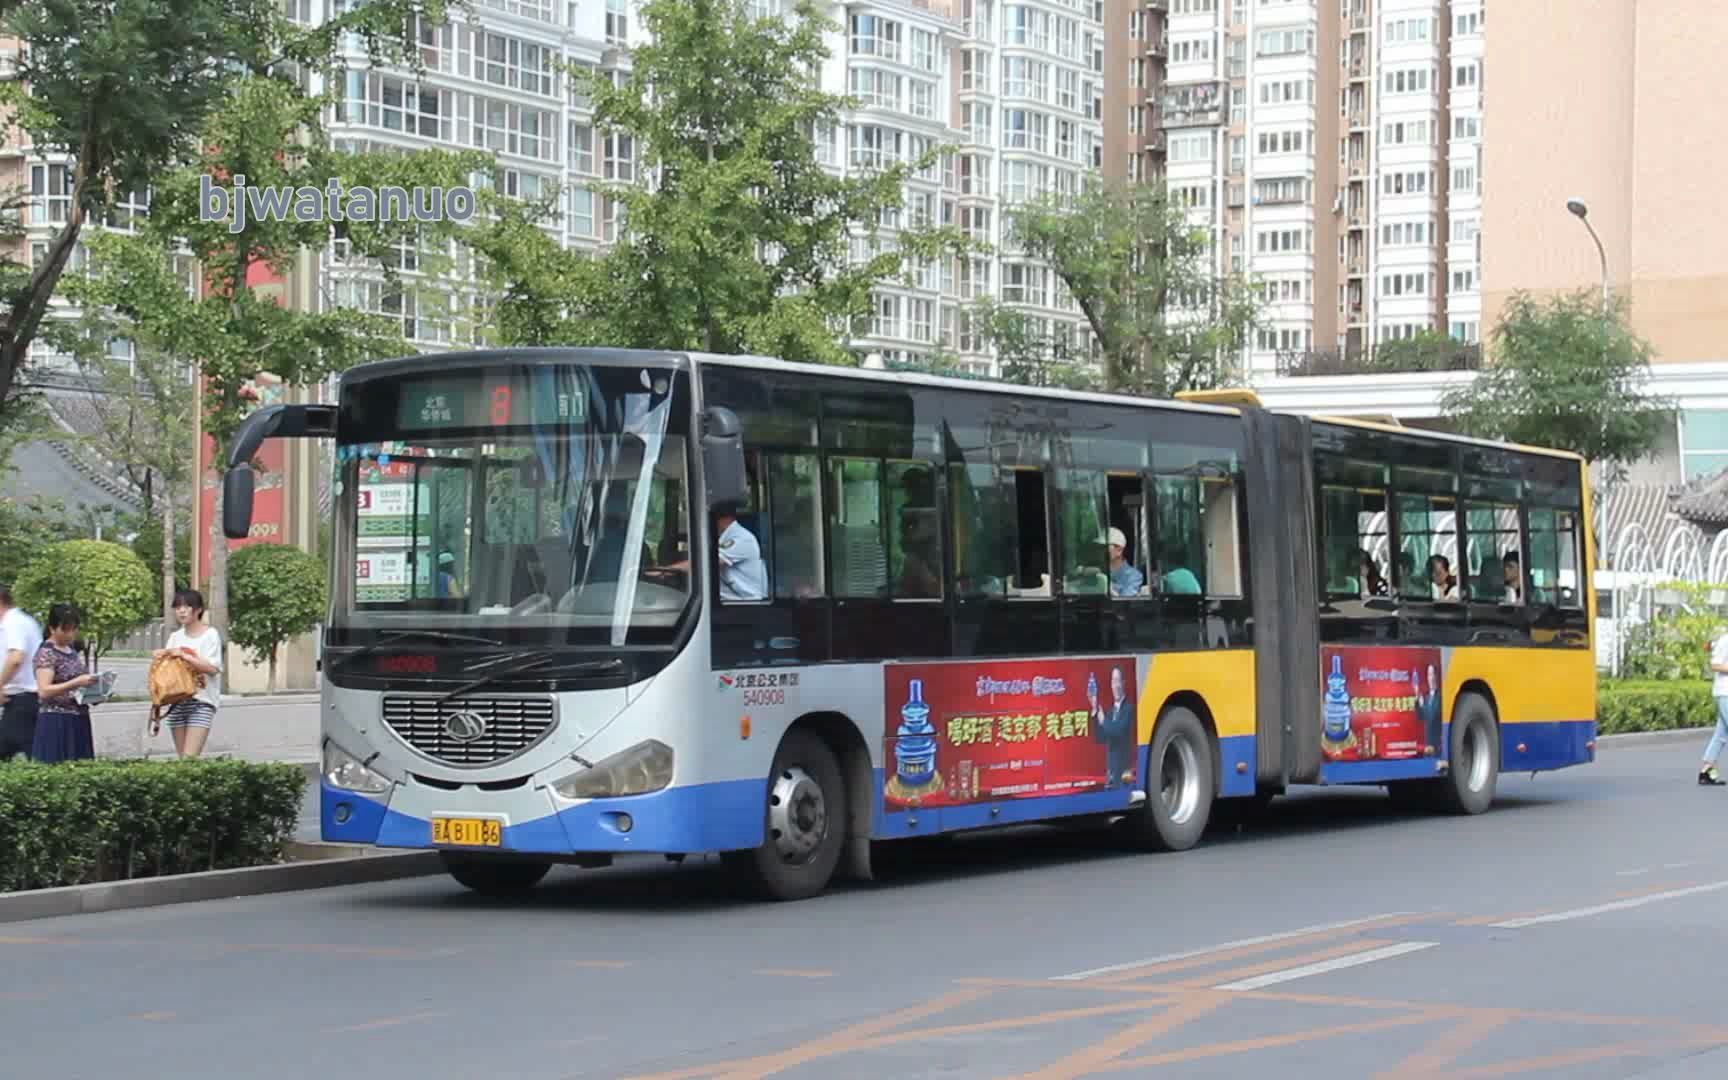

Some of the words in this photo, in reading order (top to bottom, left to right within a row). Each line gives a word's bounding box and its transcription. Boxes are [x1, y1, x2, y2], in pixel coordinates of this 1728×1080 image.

[491, 386, 512, 425] 8
[735, 673, 799, 689] 北京公交集团
[744, 689, 784, 706] 540908
[947, 716, 993, 746] 喝好酒
[1046, 710, 1089, 740] 我高明
